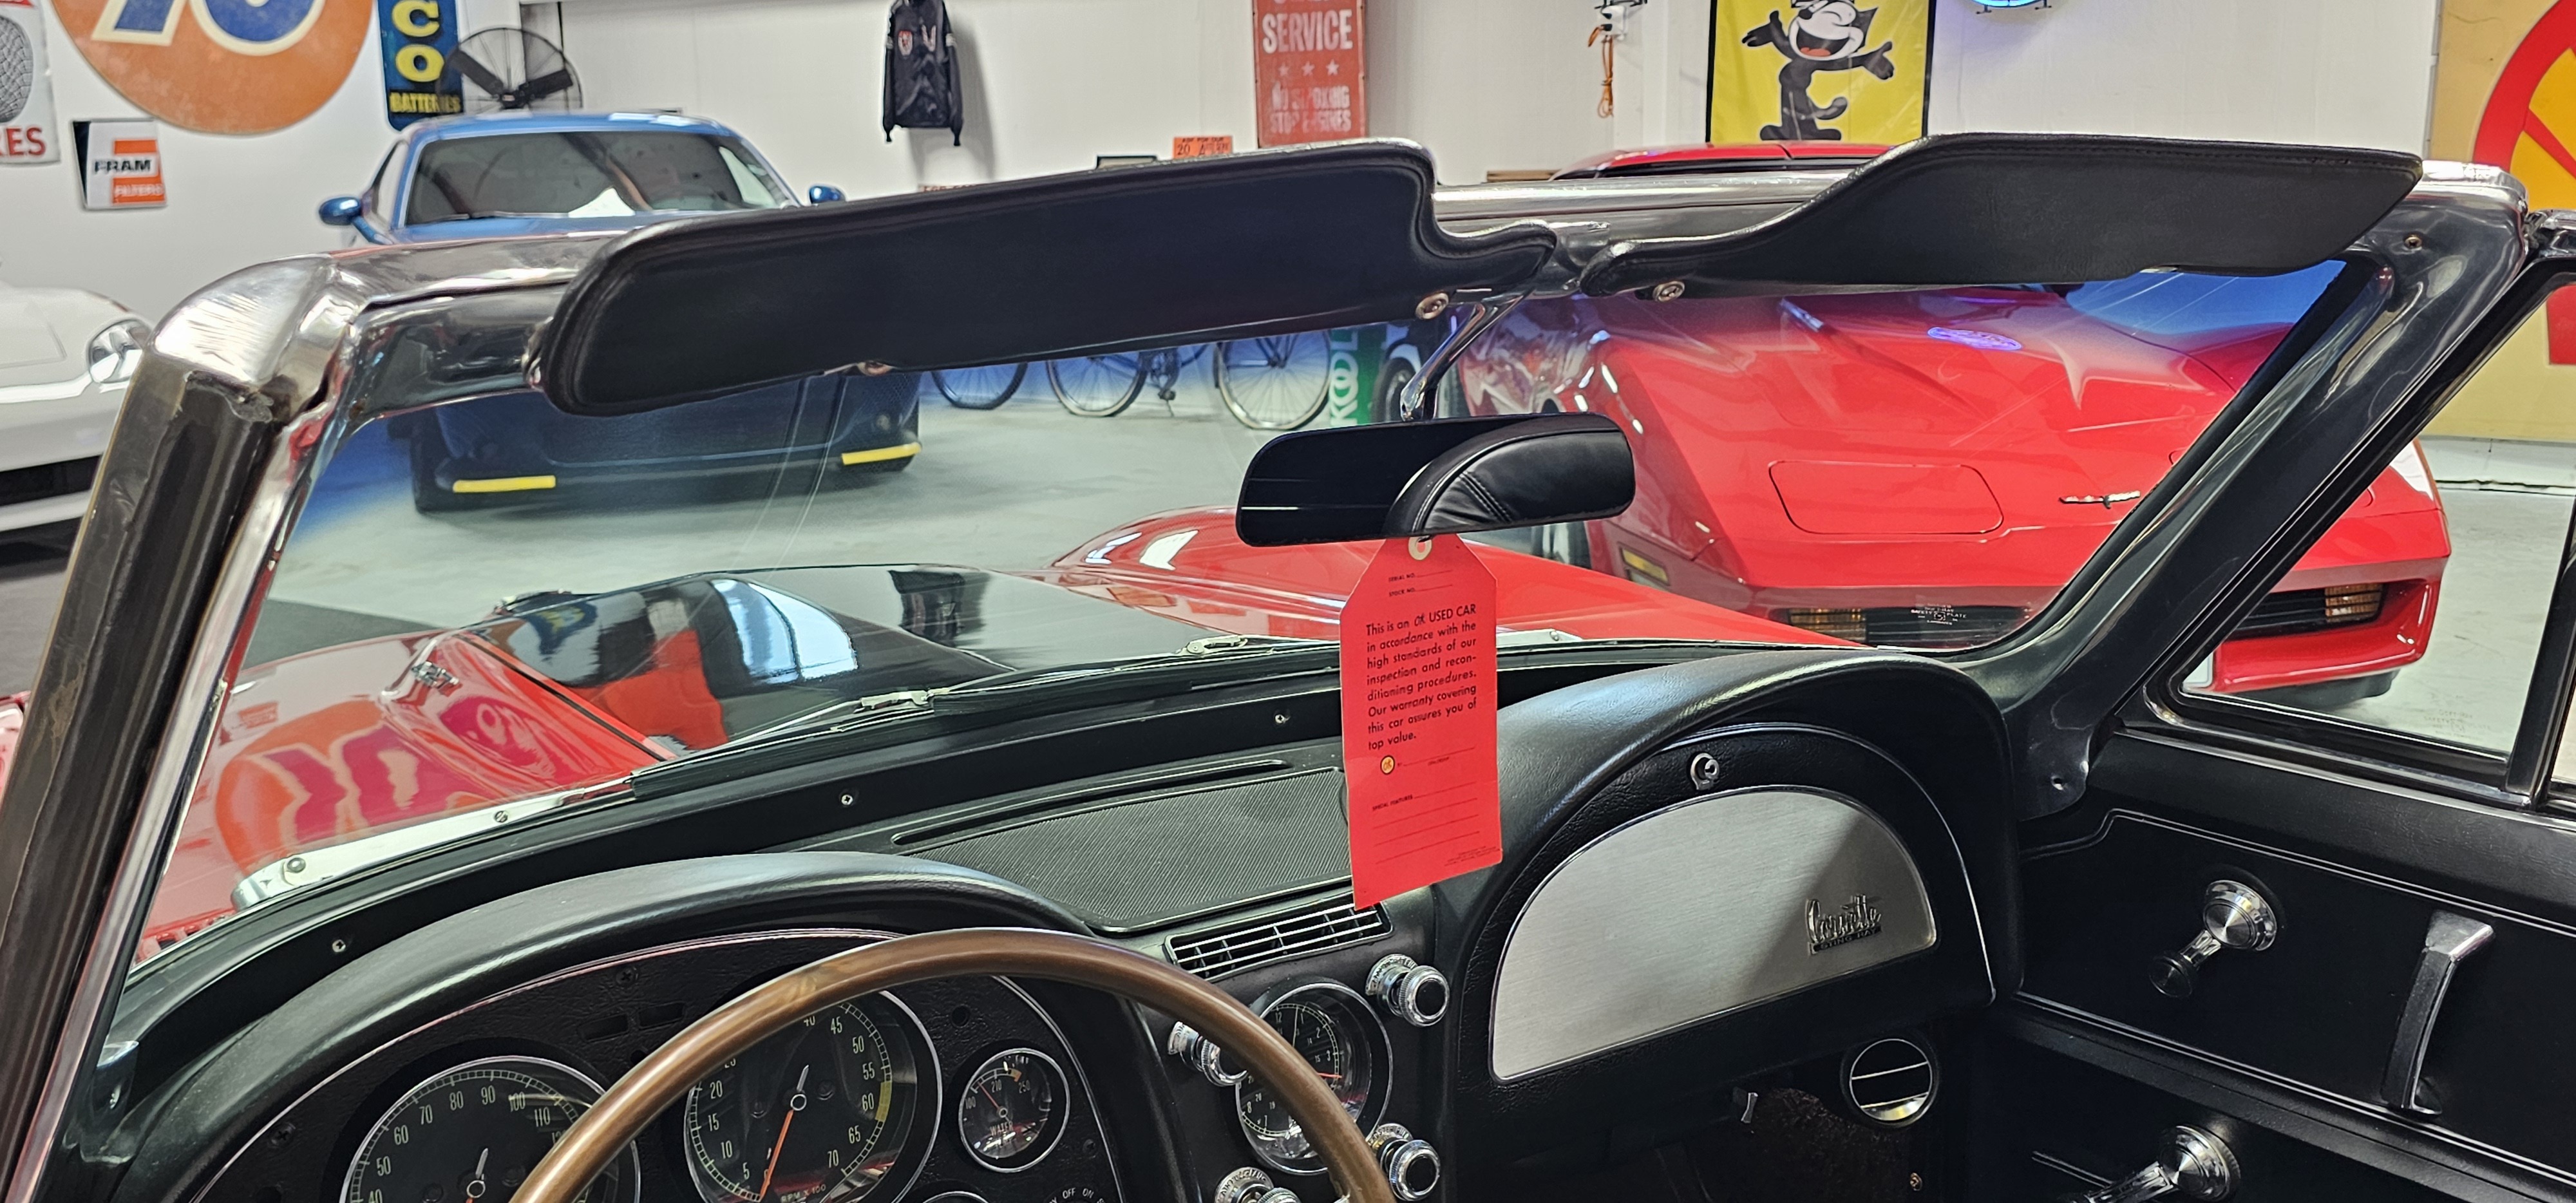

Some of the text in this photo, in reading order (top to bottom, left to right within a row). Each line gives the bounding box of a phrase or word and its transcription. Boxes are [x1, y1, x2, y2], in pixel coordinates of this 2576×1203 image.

[1262, 9, 1353, 53] SERVICE
[0, 128, 46, 156] ES
[94, 159, 151, 173] FRAM
[1330, 330, 1359, 426] KOOL
[1366, 621, 1384, 636] This
[1387, 621, 1394, 632] is
[1397, 620, 1409, 630] an
[1429, 609, 1454, 622] USED
[1456, 603, 1476, 617] CAR
[1367, 620, 1476, 652] in accordance with the
[1367, 638, 1476, 669] high standards of our
[1367, 655, 1477, 685] inspection and recon-
[1367, 670, 1477, 701] ditioning procedures.
[1368, 685, 1476, 717] Our warranty covering
[1368, 697, 1477, 734] this car assures you of
[1368, 731, 1417, 751] top value.
[831, 1016, 842, 1034] 45
[1316, 1027, 1321, 1038] 2
[852, 1036, 864, 1054] 50
[1327, 1050, 1331, 1061] 3
[863, 1062, 875, 1079] 55
[481, 1085, 495, 1105] 90
[710, 1080, 723, 1099] 20
[991, 1079, 1002, 1093] 210
[1019, 1079, 1030, 1094] 250
[450, 1091, 464, 1111] 80
[508, 1091, 526, 1112] 100
[862, 1094, 874, 1112] 60
[1247, 1101, 1252, 1113] 8
[419, 1104, 433, 1124] 70
[535, 1106, 550, 1127] 110
[708, 1114, 719, 1132] 15
[393, 1125, 408, 1145] 60
[849, 1126, 861, 1144] 65
[990, 1121, 1014, 1136] WATER
[721, 1141, 733, 1159] 10
[828, 1150, 839, 1168] 70
[376, 1156, 391, 1176] 50
[743, 1162, 750, 1180] 5
[368, 1189, 383, 1203] 40
[781, 1191, 800, 1203] RPM
[812, 1184, 826, 1194] 100
[1063, 1187, 1076, 1199] OFF
[1083, 1188, 1094, 1198] ON
